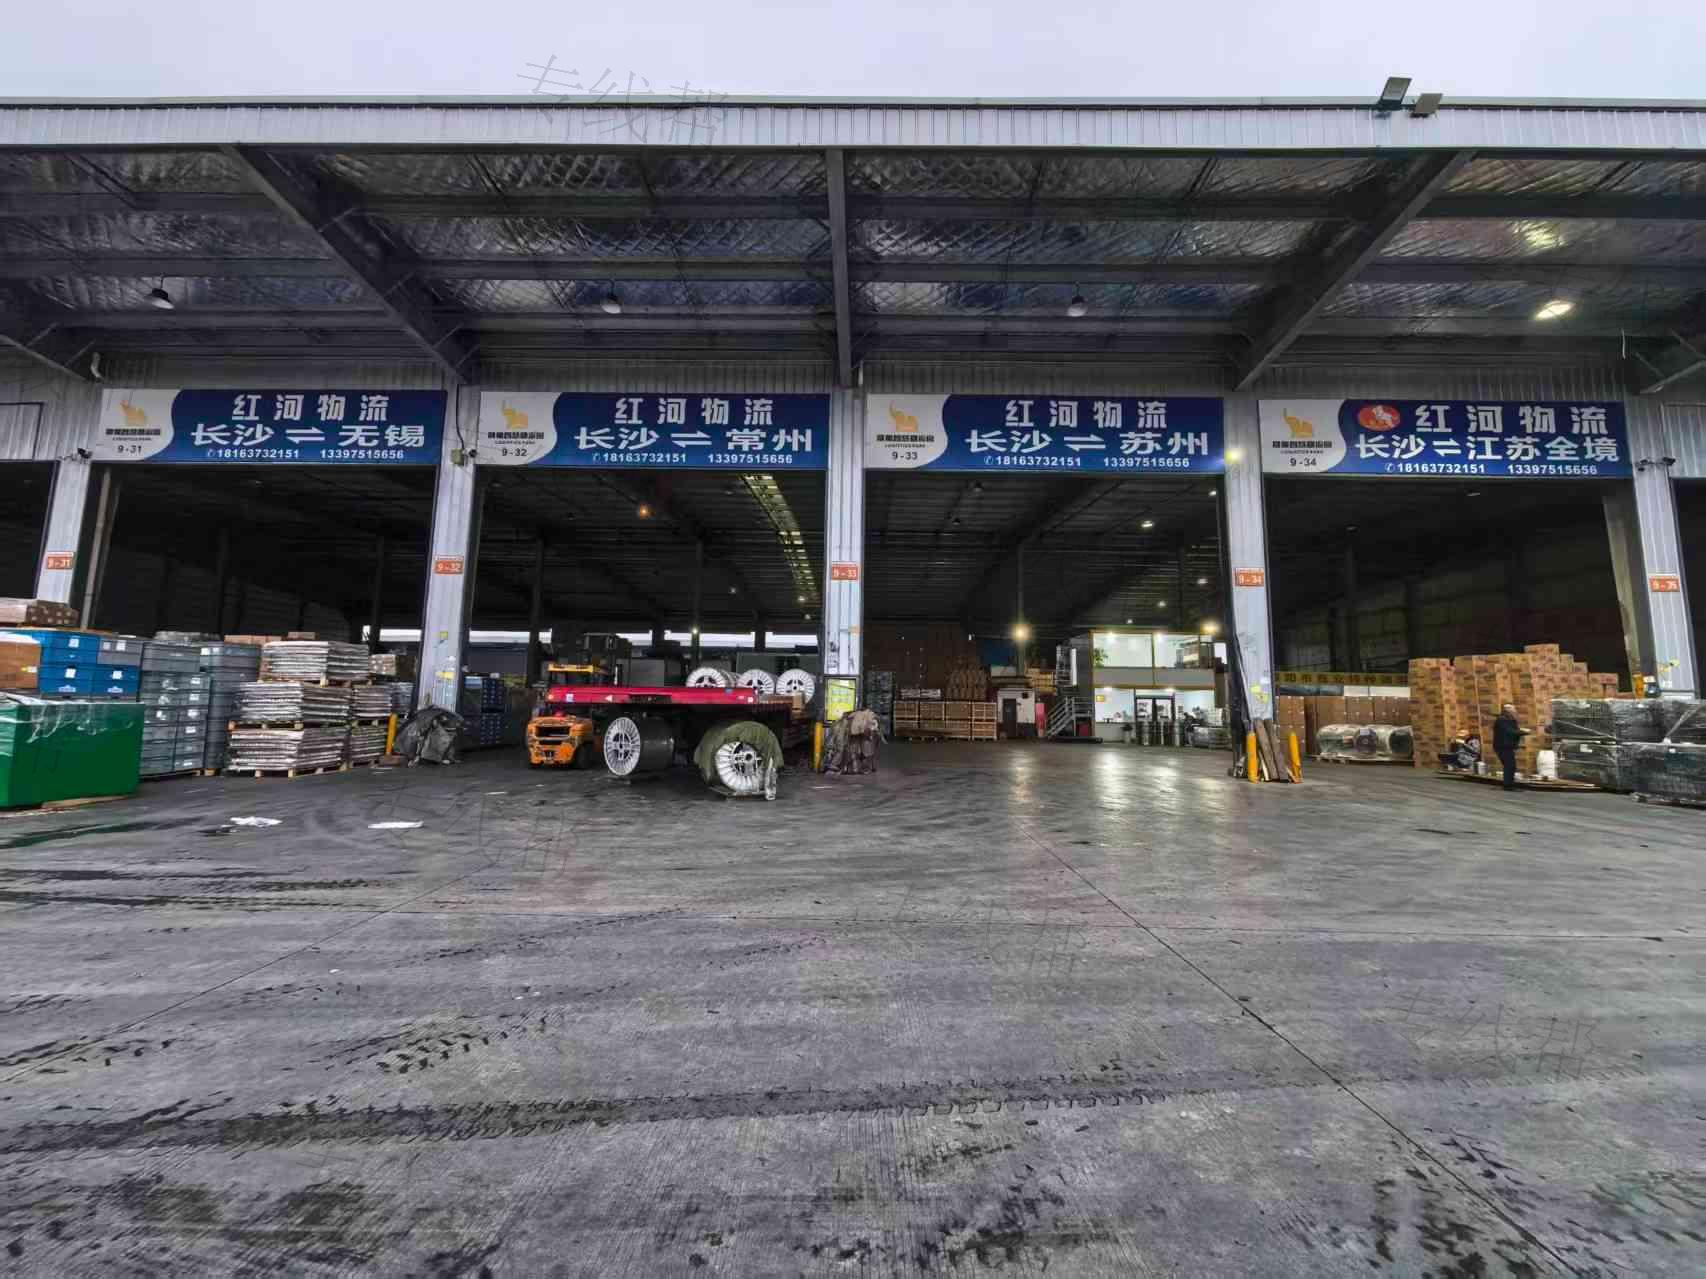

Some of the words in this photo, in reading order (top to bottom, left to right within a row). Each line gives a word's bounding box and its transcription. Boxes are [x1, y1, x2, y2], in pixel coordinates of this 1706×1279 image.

[231, 394, 390, 421] 红河物流
[614, 397, 774, 425] 红河物流
[1005, 399, 1167, 428] 红河物流
[1415, 405, 1608, 434] 红河物流
[217, 448, 299, 458] 18163732151
[320, 449, 404, 459] 13397515656
[603, 452, 686, 463] 18163732151
[708, 453, 793, 464] 13397515656
[996, 455, 1081, 466] 18163732151
[1103, 457, 1190, 468] 13397515656
[1396, 463, 1486, 474] 18163732151
[1507, 464, 1598, 475] 13397515656
